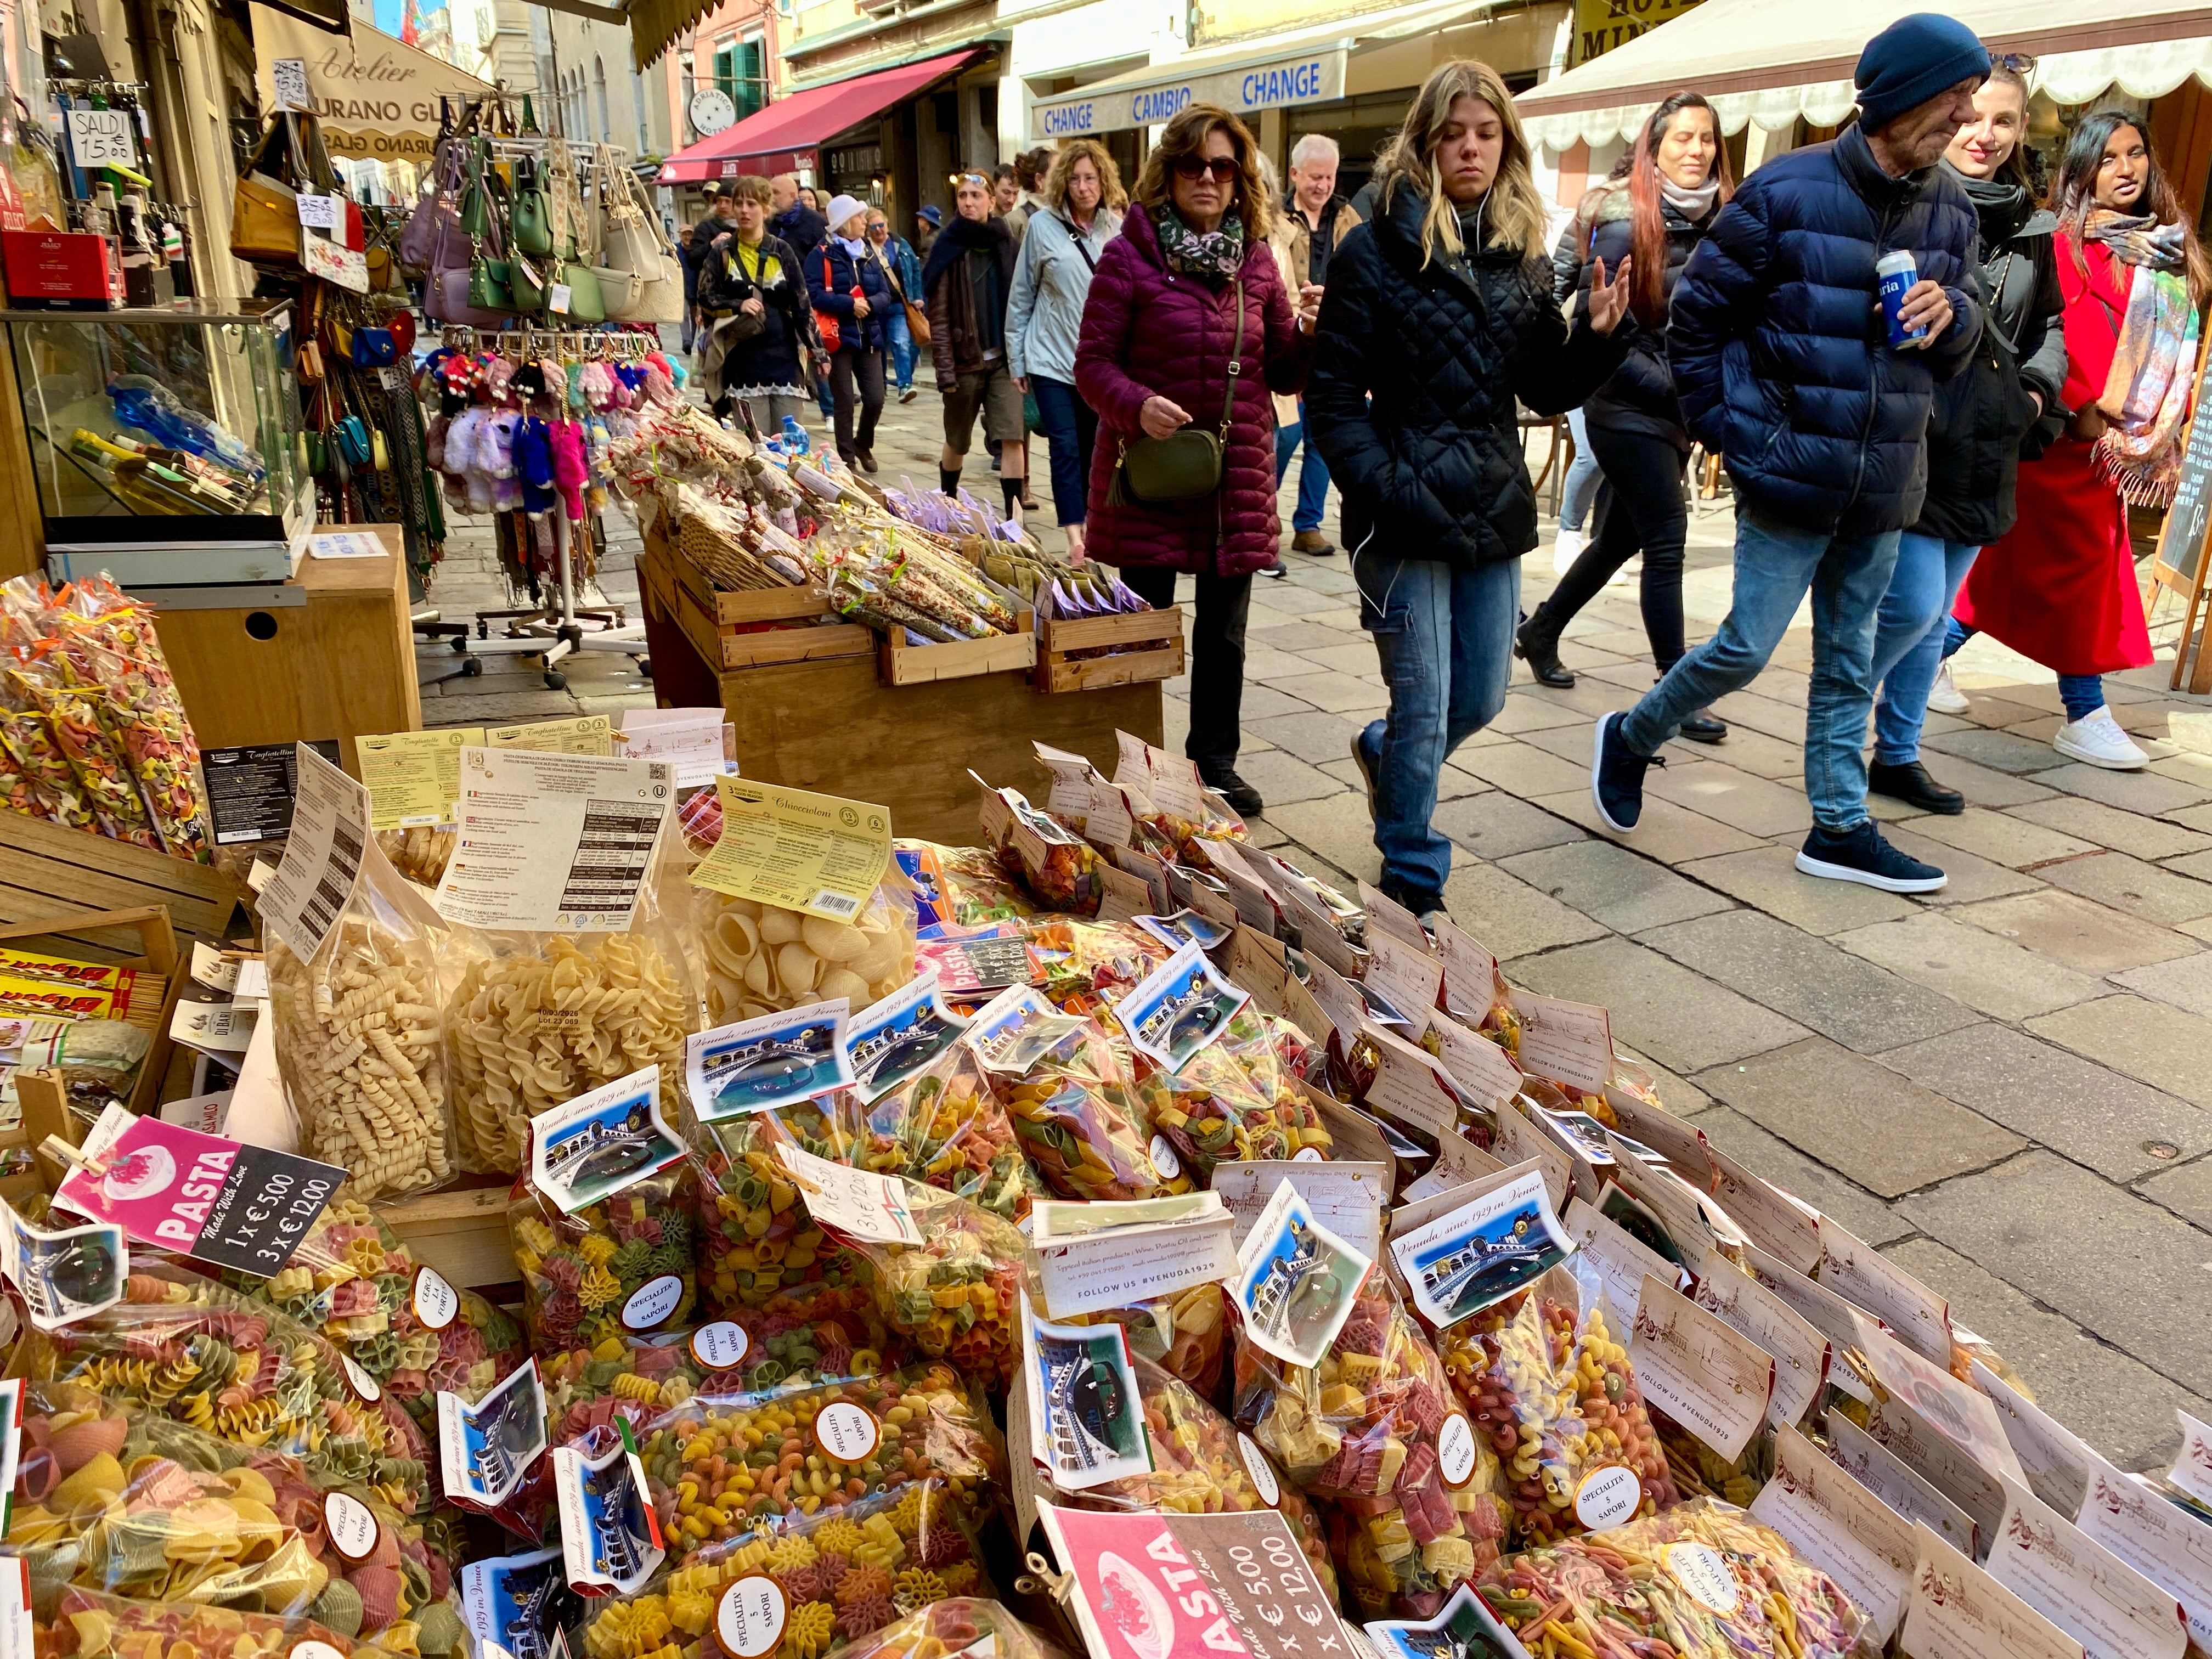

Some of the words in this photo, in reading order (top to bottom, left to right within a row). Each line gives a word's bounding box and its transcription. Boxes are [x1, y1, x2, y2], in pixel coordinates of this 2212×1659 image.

[1581, 18, 1673, 61] MIN
[307, 47, 417, 82] Atelier
[1243, 63, 1320, 105] CHANGE
[314, 98, 401, 121] URANO
[693, 91, 731, 111] ADRIATICO
[1132, 87, 1191, 122] CAMBIO
[76, 113, 125, 136] SALDI
[700, 123, 729, 135] HOTEL
[1045, 104, 1092, 134] CHANGE
[81, 138, 128, 159] 15.00
[246, 748, 295, 760] Tagliatelline
[401, 736, 439, 748] Tagliatelle
[771, 796, 832, 819] Chioccioloni
[943, 947, 978, 986] PASTA
[1119, 995, 1144, 1020] Venuda
[1145, 981, 1159, 997] since
[1160, 970, 1172, 985] 1929
[1173, 964, 1180, 972] in
[1180, 947, 1199, 965] Venice
[865, 1012, 885, 1025] since
[886, 1000, 901, 1015] 1929
[902, 995, 912, 1005] in
[912, 979, 936, 997] Venice
[1451, 993, 1477, 1015] #VENUDA1929
[692, 1030, 741, 1051] Venuda
[741, 1024, 769, 1036] since
[771, 1016, 792, 1030] 1929
[794, 1013, 808, 1022] in
[812, 1005, 847, 1021] Venice
[1529, 1056, 1549, 1066] FOLLOW
[1558, 1066, 1594, 1081] #VENUDA1929
[204, 1104, 218, 1119] MILO
[537, 1109, 572, 1136] Venuda
[573, 1101, 595, 1116] since
[597, 1092, 614, 1107] 1929
[617, 1088, 627, 1098] in
[630, 1076, 658, 1093] Venice
[1383, 1093, 1402, 1107] FOLLOW
[1410, 1106, 1440, 1126] #VENUDA192
[1307, 1169, 1333, 1178] Spagna
[155, 1151, 236, 1242] PASTA
[202, 1212, 225, 1239] Made
[216, 1187, 237, 1210] With
[229, 1165, 247, 1187] Love
[257, 1174, 294, 1207] 5,00
[290, 1179, 330, 1217] 12,00
[246, 1206, 270, 1222] €
[279, 1217, 303, 1233] €
[857, 1219, 878, 1231] 3
[1248, 1242, 1265, 1263] since
[1263, 1224, 1274, 1243] 1929
[1273, 1214, 1280, 1225] in
[1277, 1189, 1295, 1214] Venice
[1398, 1228, 1442, 1257] Venuda
[1444, 1218, 1470, 1234] since
[1472, 1205, 1492, 1222] 1929
[1494, 1200, 1506, 1210] in
[1508, 1182, 1542, 1203] Venice
[225, 1237, 248, 1248] 1
[238, 1224, 258, 1238] x
[271, 1236, 292, 1250] x
[256, 1249, 280, 1262] 3
[1056, 1259, 1081, 1273] Typical
[1082, 1256, 1101, 1267] italian
[1102, 1251, 1131, 1265] products
[1135, 1246, 1154, 1256] Wine,
[1155, 1241, 1177, 1252] Pasta,
[1178, 1237, 1189, 1246] Oil
[1189, 1234, 1202, 1243] and
[1203, 1232, 1218, 1240] more
[422, 1276, 432, 1303] CERCA
[1078, 1284, 1119, 1299] FOLLOW
[1124, 1280, 1136, 1289] US
[1143, 1263, 1215, 1285] #VENUDA1929
[631, 1282, 674, 1310] SPECIALITA'
[641, 1302, 669, 1322] SAPORI
[731, 1330, 740, 1352] SAPORI
[1640, 1372, 1669, 1395] FOLLOW
[1670, 1392, 1679, 1403] US
[1681, 1402, 1729, 1440] #VENUDA1929
[827, 1413, 847, 1453] SPECIALITA'
[852, 1416, 867, 1441] SAPORI
[1443, 1421, 1463, 1459] SPECIALITA'
[563, 1451, 575, 1478] Venice
[1455, 1449, 1470, 1474] SAPORI
[568, 1477, 577, 1491] in
[1582, 1474, 1624, 1503] SPECIALITA'
[571, 1494, 583, 1514] 1929
[1598, 1500, 1627, 1521] SAPORI
[357, 1515, 368, 1545] SAPORI
[574, 1541, 588, 1579] Venuda
[1191, 1549, 1220, 1583] Love
[1228, 1545, 1273, 1595] 5,00
[1261, 1536, 1311, 1597] 12,00
[1697, 1552, 1728, 1592] SAPORI
[470, 1564, 483, 1596] Venice
[1671, 1551, 1719, 1608] SPECIALITA'
[474, 1597, 484, 1609] in
[760, 1593, 773, 1628] SAPORI
[1210, 1587, 1245, 1624] With
[1255, 1603, 1284, 1627] €
[1294, 1603, 1323, 1627] €
[477, 1612, 488, 1630] 1929
[733, 1593, 748, 1647] SPECIALITA'
[1277, 1633, 1303, 1651] x
[1316, 1633, 1342, 1652] x
